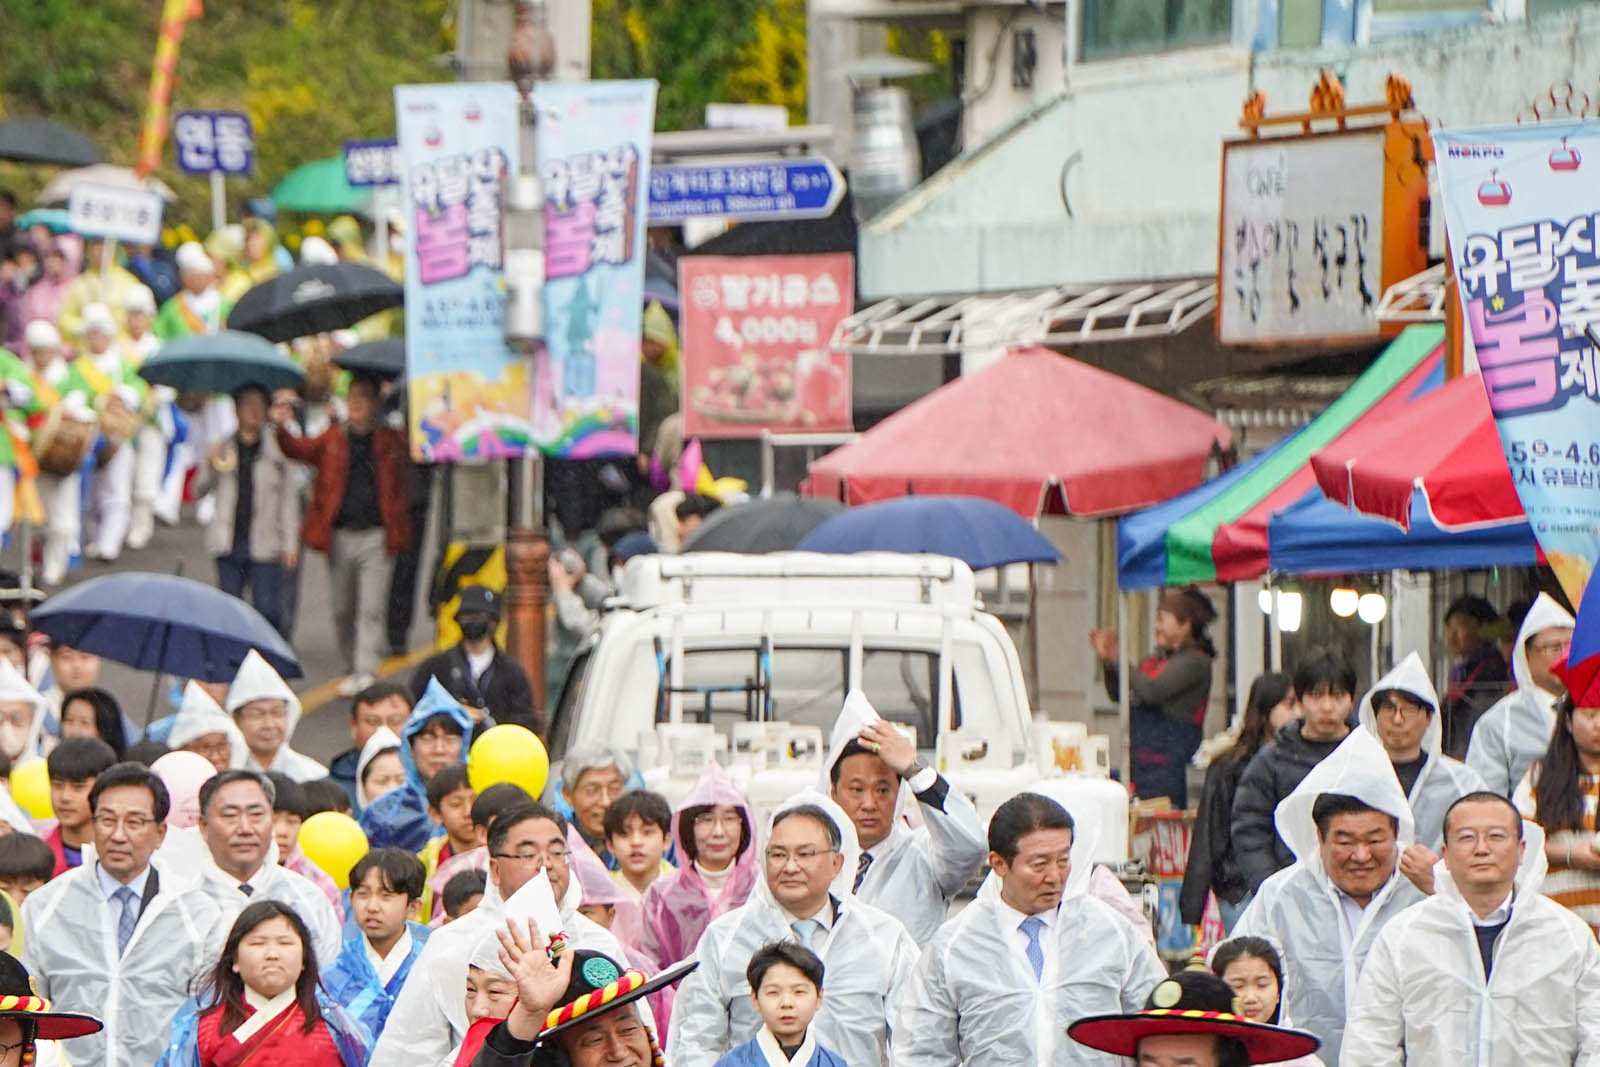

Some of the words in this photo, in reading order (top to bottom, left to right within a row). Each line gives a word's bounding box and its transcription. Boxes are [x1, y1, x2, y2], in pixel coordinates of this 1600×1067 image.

[410, 147, 504, 206] 유달산
[542, 143, 636, 206] 유달산
[1448, 148, 1504, 159] MOKPO
[416, 200, 470, 285] 봄
[545, 198, 597, 282] 봄
[1467, 286, 1560, 415] 봄
[1542, 467, 1600, 489] 유달산
